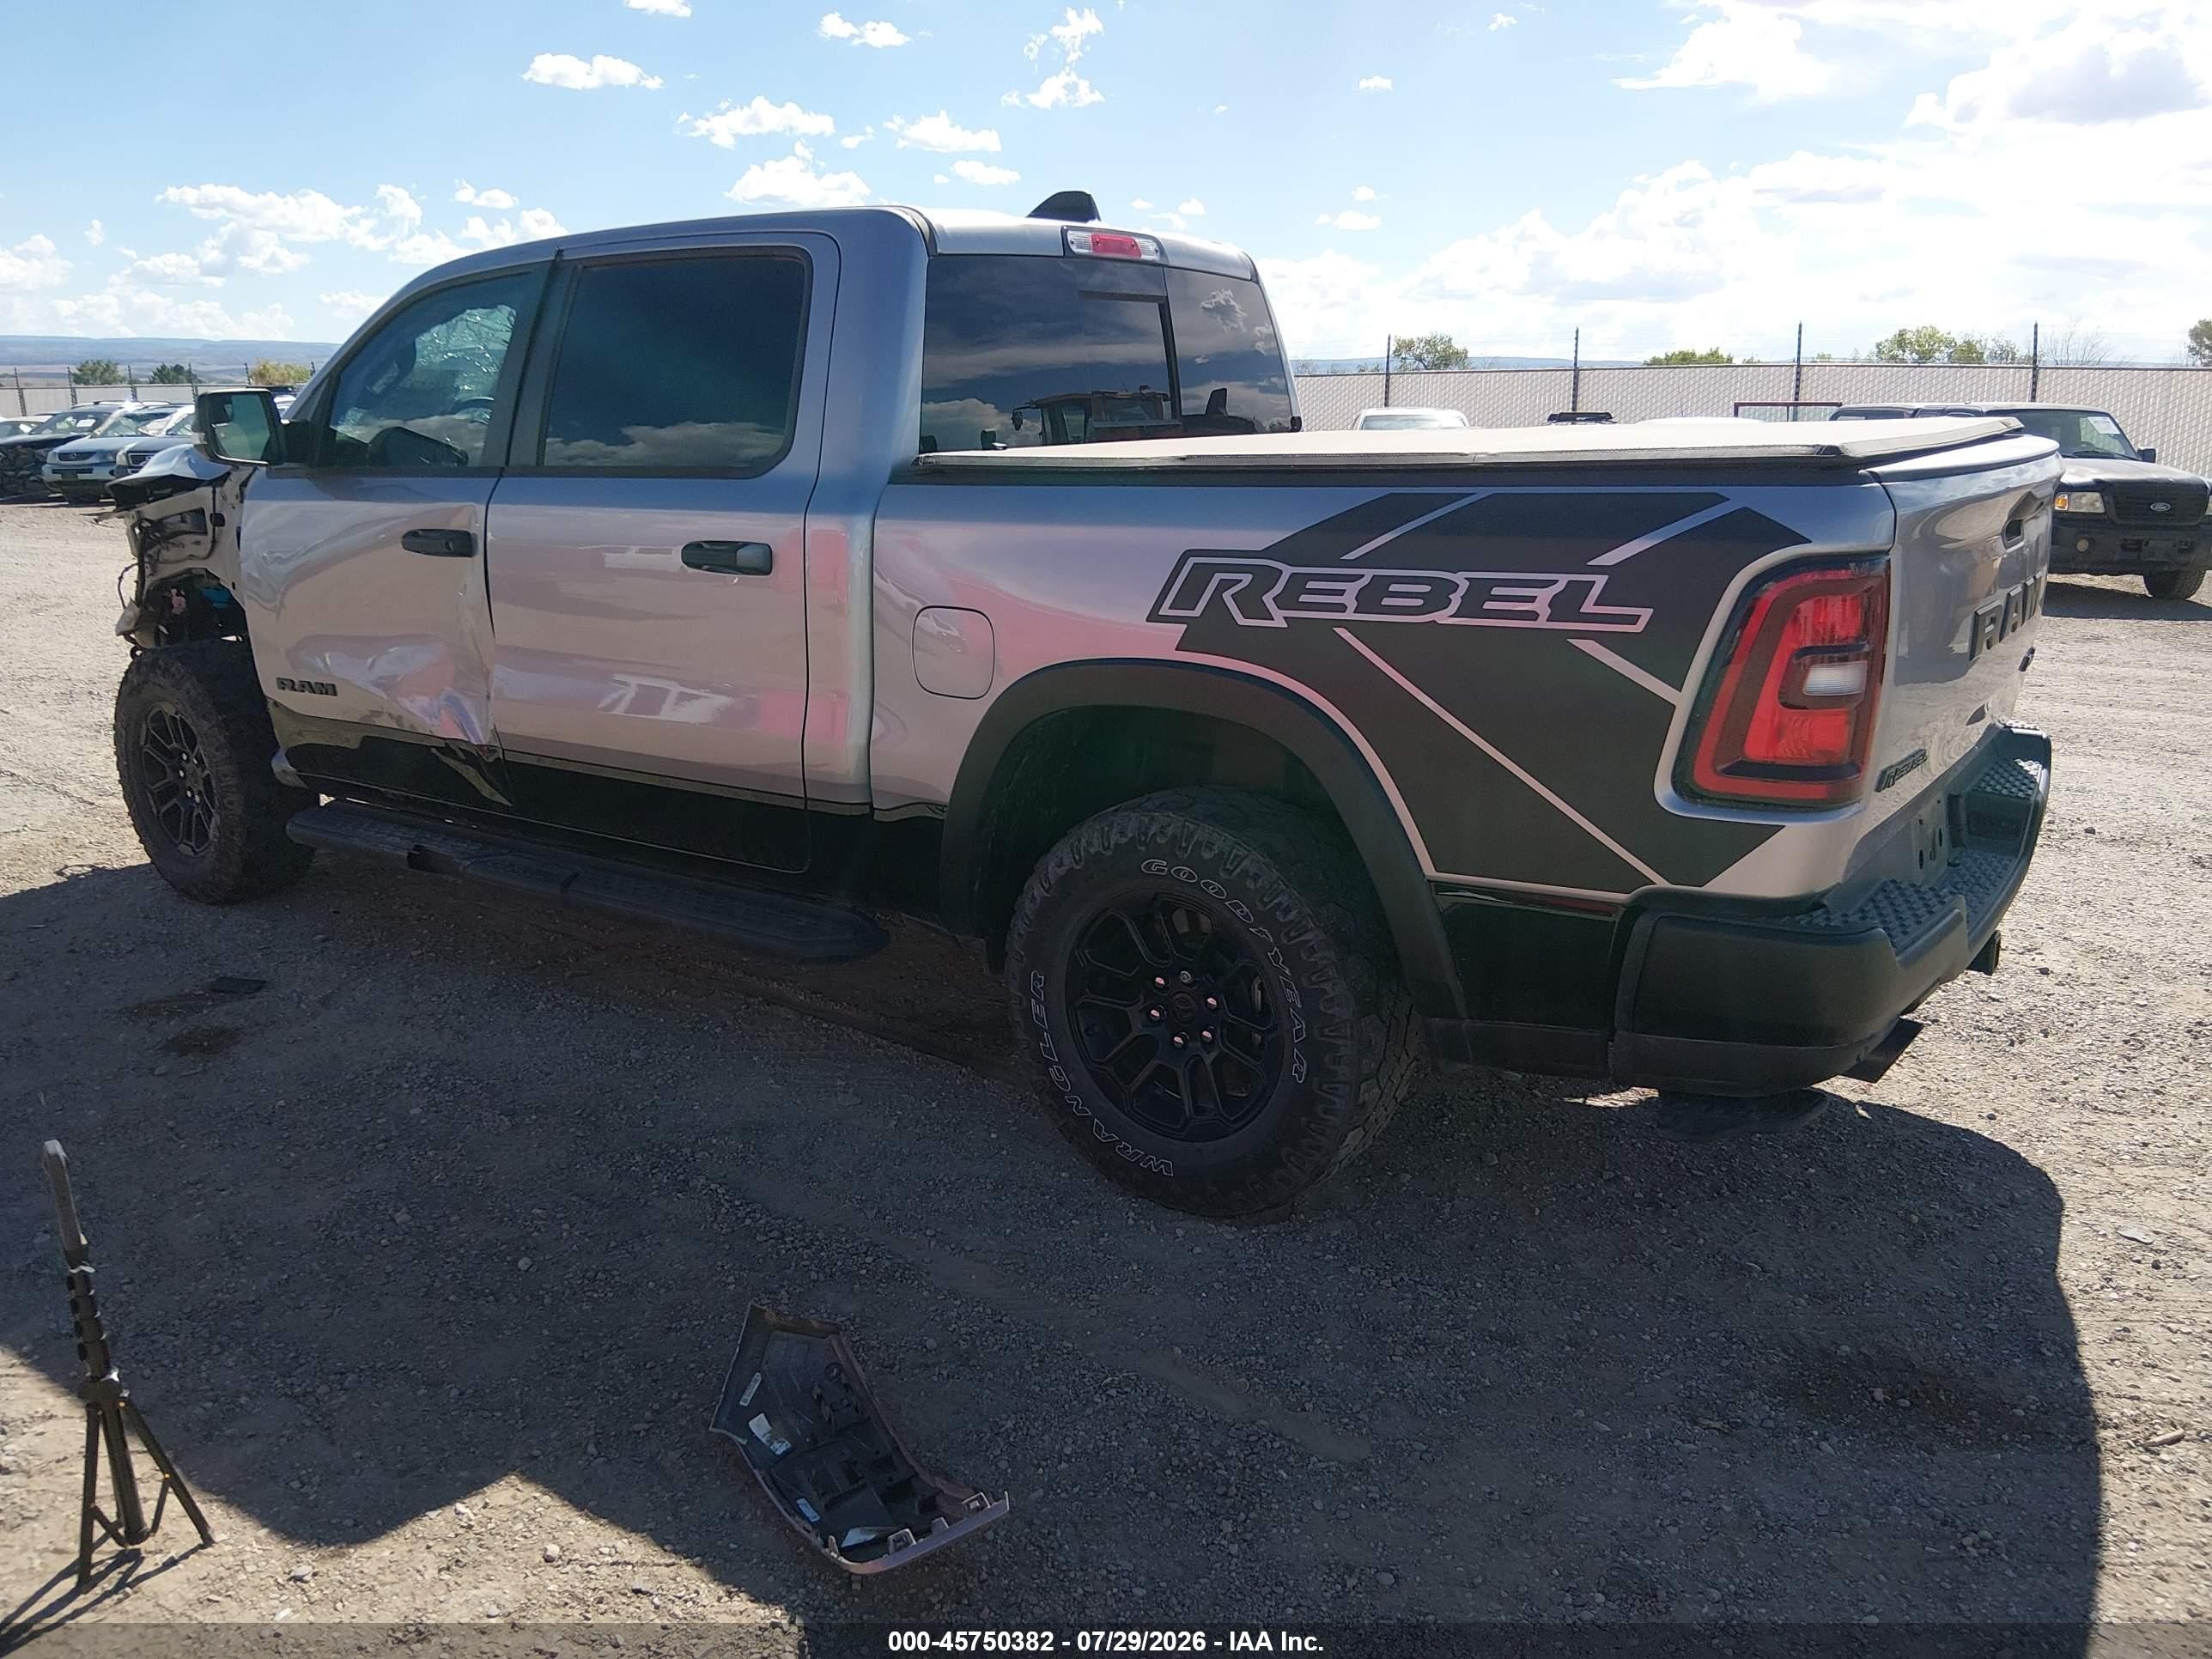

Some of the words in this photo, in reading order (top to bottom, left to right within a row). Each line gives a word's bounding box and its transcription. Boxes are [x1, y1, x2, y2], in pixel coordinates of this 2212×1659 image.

[1156, 556, 1654, 633] REBEL
[276, 677, 337, 696] RAM
[1139, 858, 1308, 1084] GOODYEAR
[1030, 969, 1176, 1177] WRANGLER
